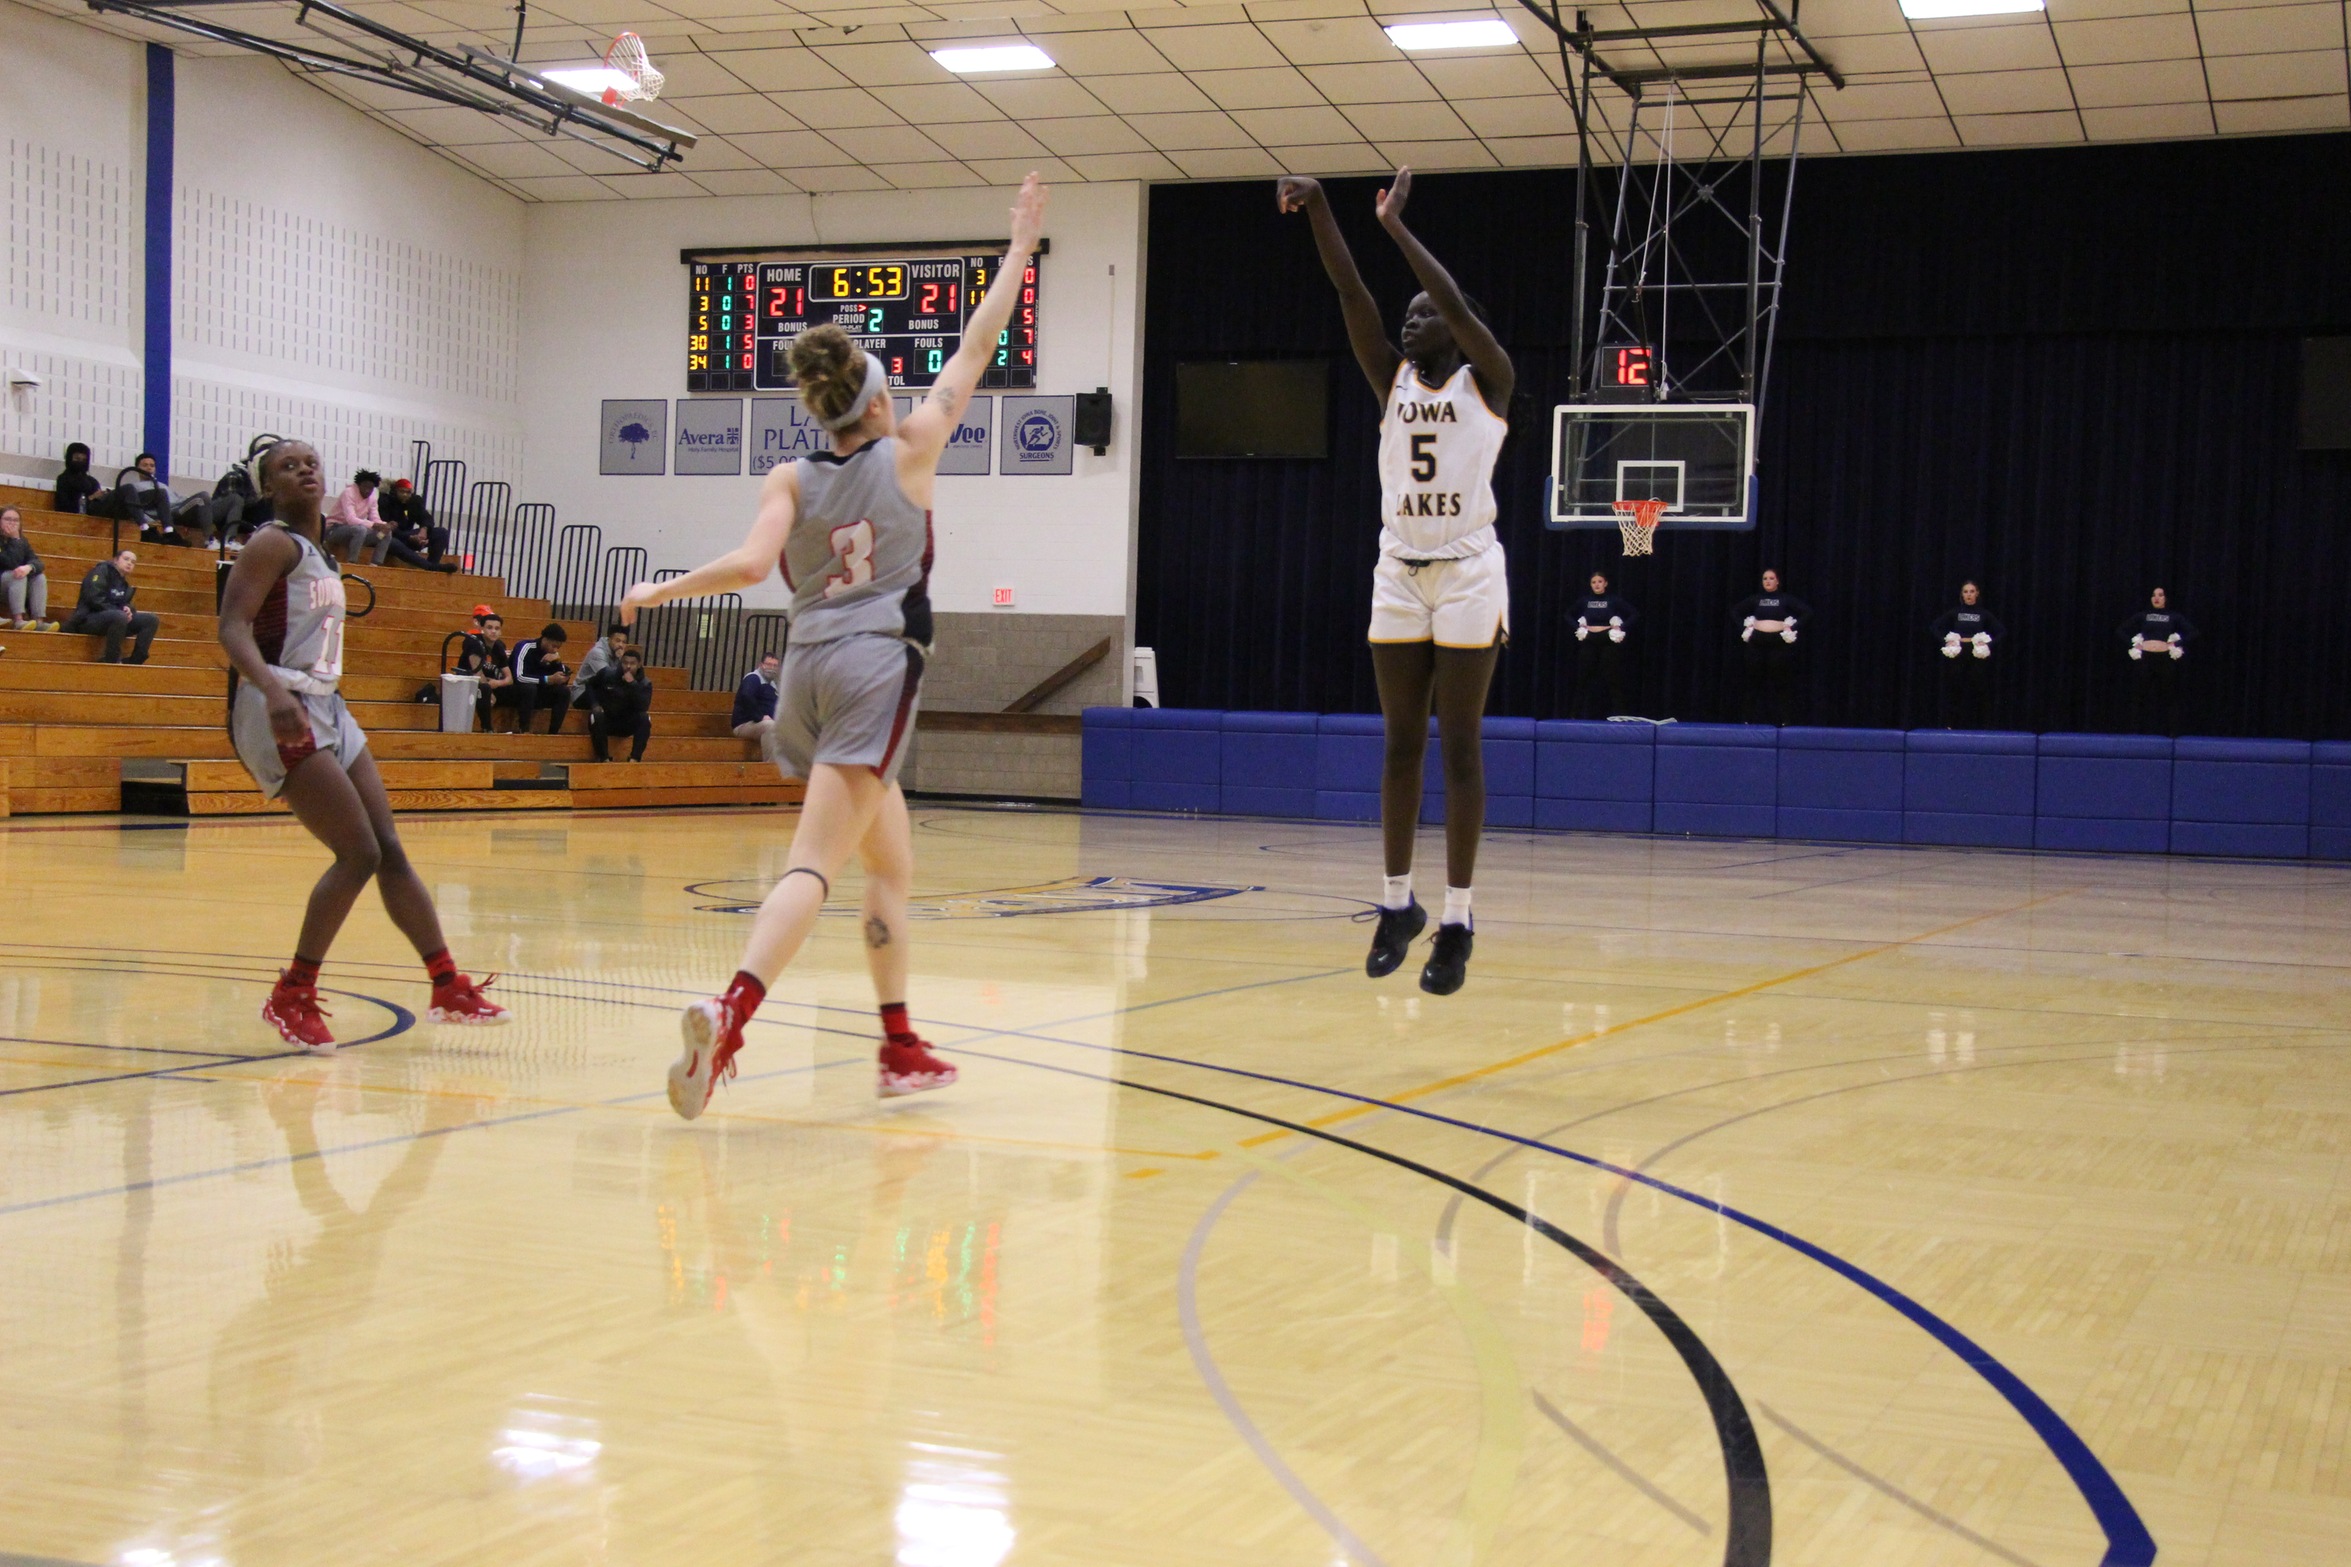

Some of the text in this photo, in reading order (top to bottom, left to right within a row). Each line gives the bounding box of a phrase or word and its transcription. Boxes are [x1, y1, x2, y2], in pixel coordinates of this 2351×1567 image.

[695, 265, 708, 275] NO
[722, 265, 728, 274] F
[737, 264, 753, 274] PTS
[970, 257, 984, 267] NO
[767, 269, 802, 282] HOME
[911, 264, 960, 279] VISITOR
[976, 269, 986, 285] 3
[1024, 268, 1035, 284] 0
[695, 277, 710, 292] 11
[727, 276, 732, 291] 1
[744, 275, 755, 291] 0
[833, 267, 902, 297] 6:53
[699, 295, 709, 312] 3
[721, 295, 732, 312] 0
[745, 294, 755, 310] 7
[769, 288, 804, 317] 21
[921, 284, 957, 313] 21
[1023, 288, 1034, 304] 0
[840, 304, 858, 313] POSS
[1022, 308, 1033, 325] 5
[698, 315, 708, 331] 5
[720, 315, 732, 331] 0
[743, 314, 754, 330] 3
[832, 313, 866, 324] PERIOD
[868, 308, 884, 332] 2
[908, 319, 940, 330] BONUS
[777, 321, 808, 333] BONUS
[689, 335, 709, 351] 30
[725, 335, 731, 350] 1
[743, 334, 754, 350] 5
[914, 338, 944, 348] FOULS
[997, 329, 1009, 346] 0
[1022, 328, 1034, 345] 7
[689, 354, 708, 370] 34
[724, 354, 731, 370] 1
[742, 353, 753, 370] 0
[891, 357, 903, 374] 3
[928, 350, 942, 373] 0
[997, 350, 1008, 366] 2
[1022, 350, 1033, 365] 4
[1617, 348, 1652, 385] 12
[888, 375, 905, 386] TOL
[678, 428, 725, 445] Avera
[1019, 452, 1055, 460] SURGEONS
[1410, 434, 1437, 482] 5
[824, 518, 876, 600] 3
[994, 588, 1013, 604] EXIT
[313, 614, 343, 676] 11
